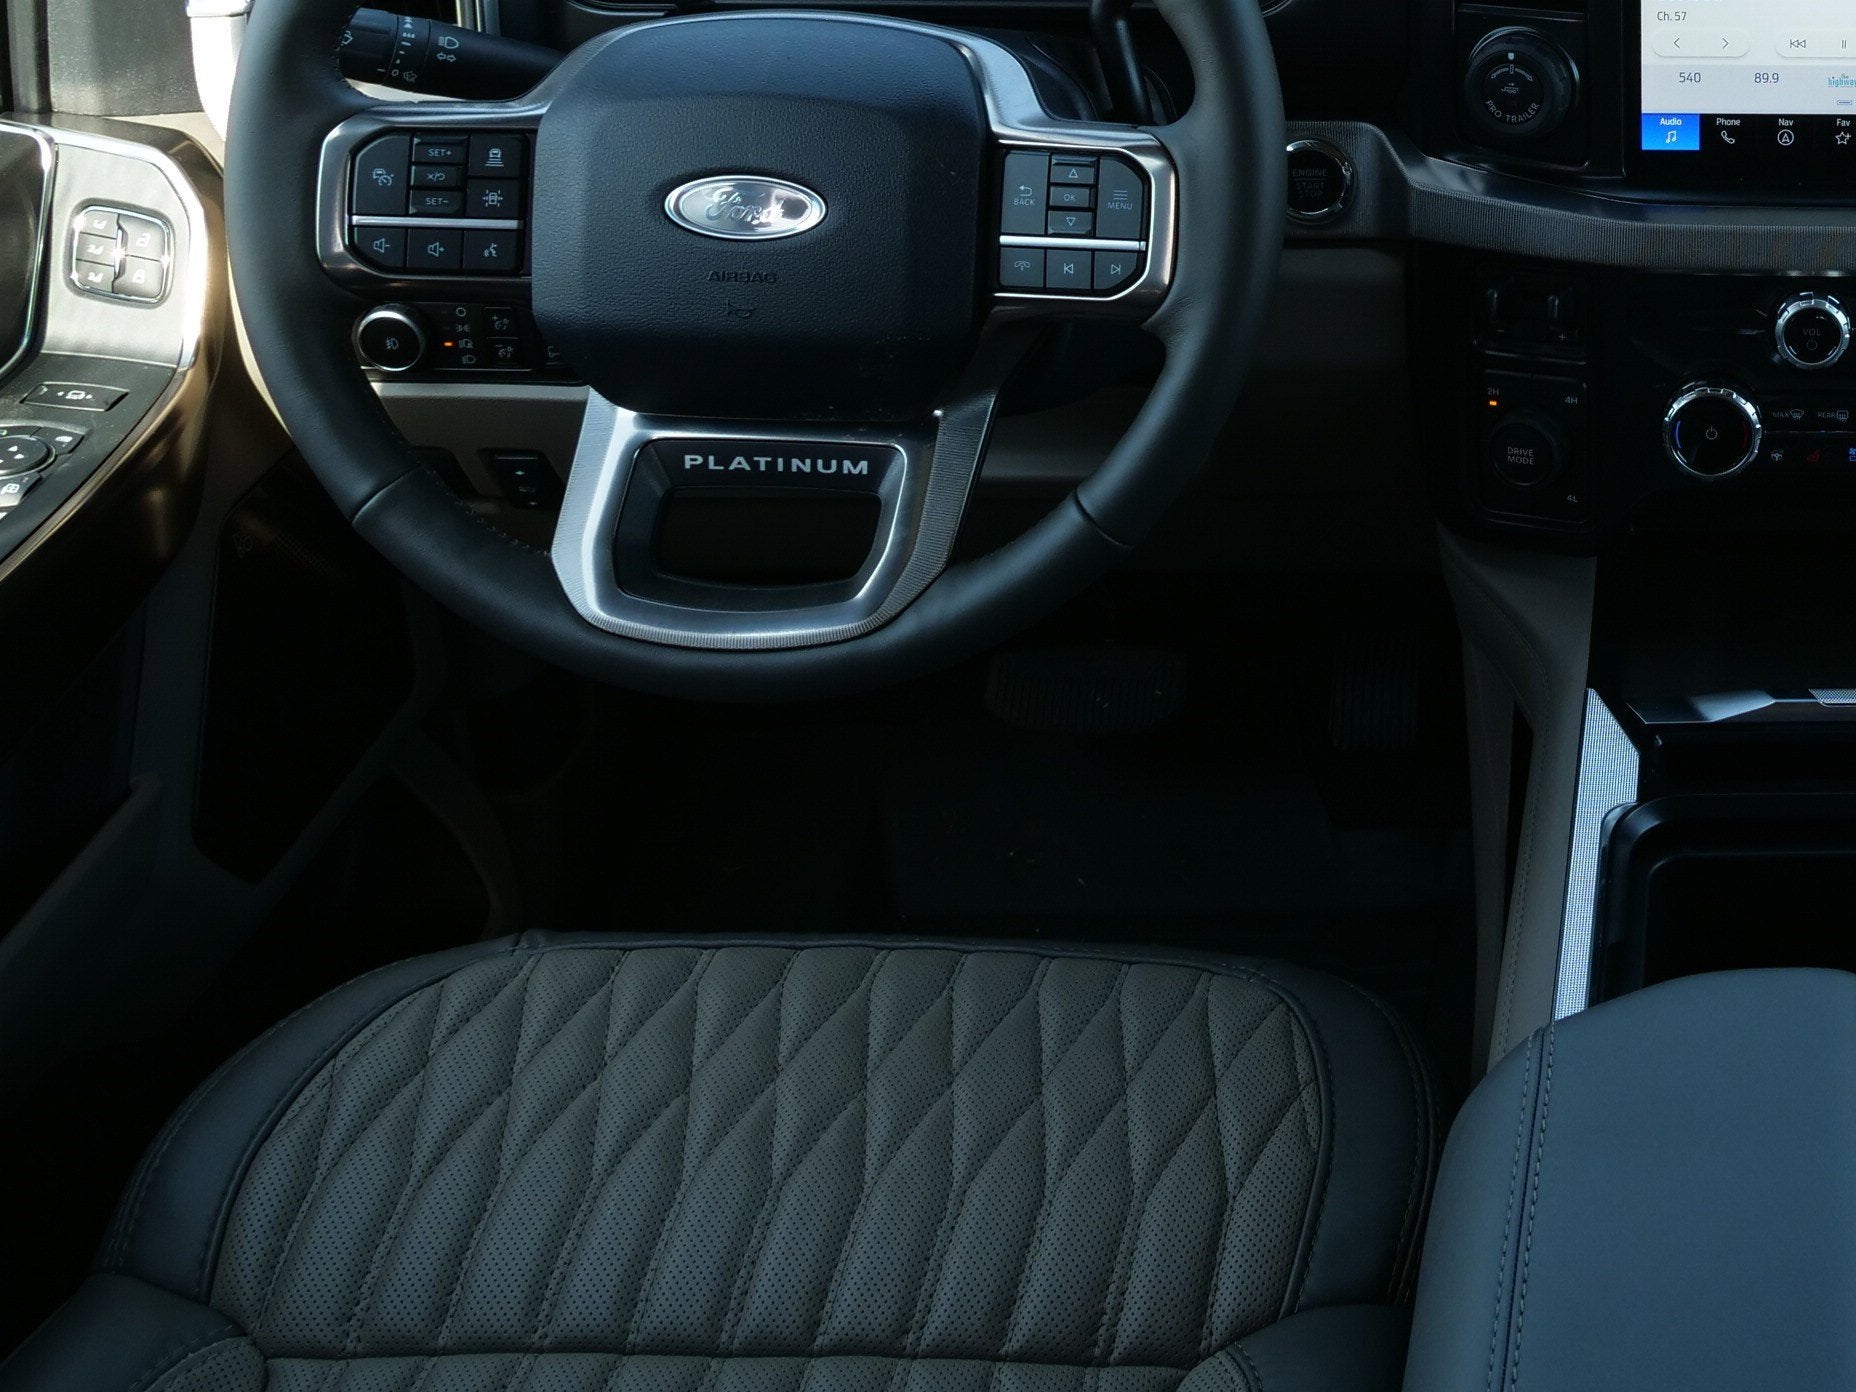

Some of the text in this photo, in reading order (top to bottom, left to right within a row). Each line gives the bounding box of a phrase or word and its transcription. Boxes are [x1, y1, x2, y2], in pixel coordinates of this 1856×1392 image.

[1657, 11, 1687, 21] Ch. 57
[1679, 72, 1701, 84] 540
[1754, 73, 1779, 84] 89.9
[1485, 99, 1540, 122] PRO TRAILER
[1660, 118, 1682, 126] Audio
[1716, 118, 1740, 126] Phone
[1778, 118, 1794, 127] Nav
[1836, 118, 1850, 127] Fav
[1013, 197, 1036, 207] BACK
[1108, 201, 1133, 211] MENU
[709, 271, 777, 283] AIRBAG
[1565, 396, 1578, 404] 4H
[1818, 411, 1836, 419] REAR
[1507, 447, 1533, 457] DRIVE
[683, 454, 870, 476] PLATINUM
[1507, 456, 1534, 465] MODE
[1567, 495, 1578, 503] 4L
